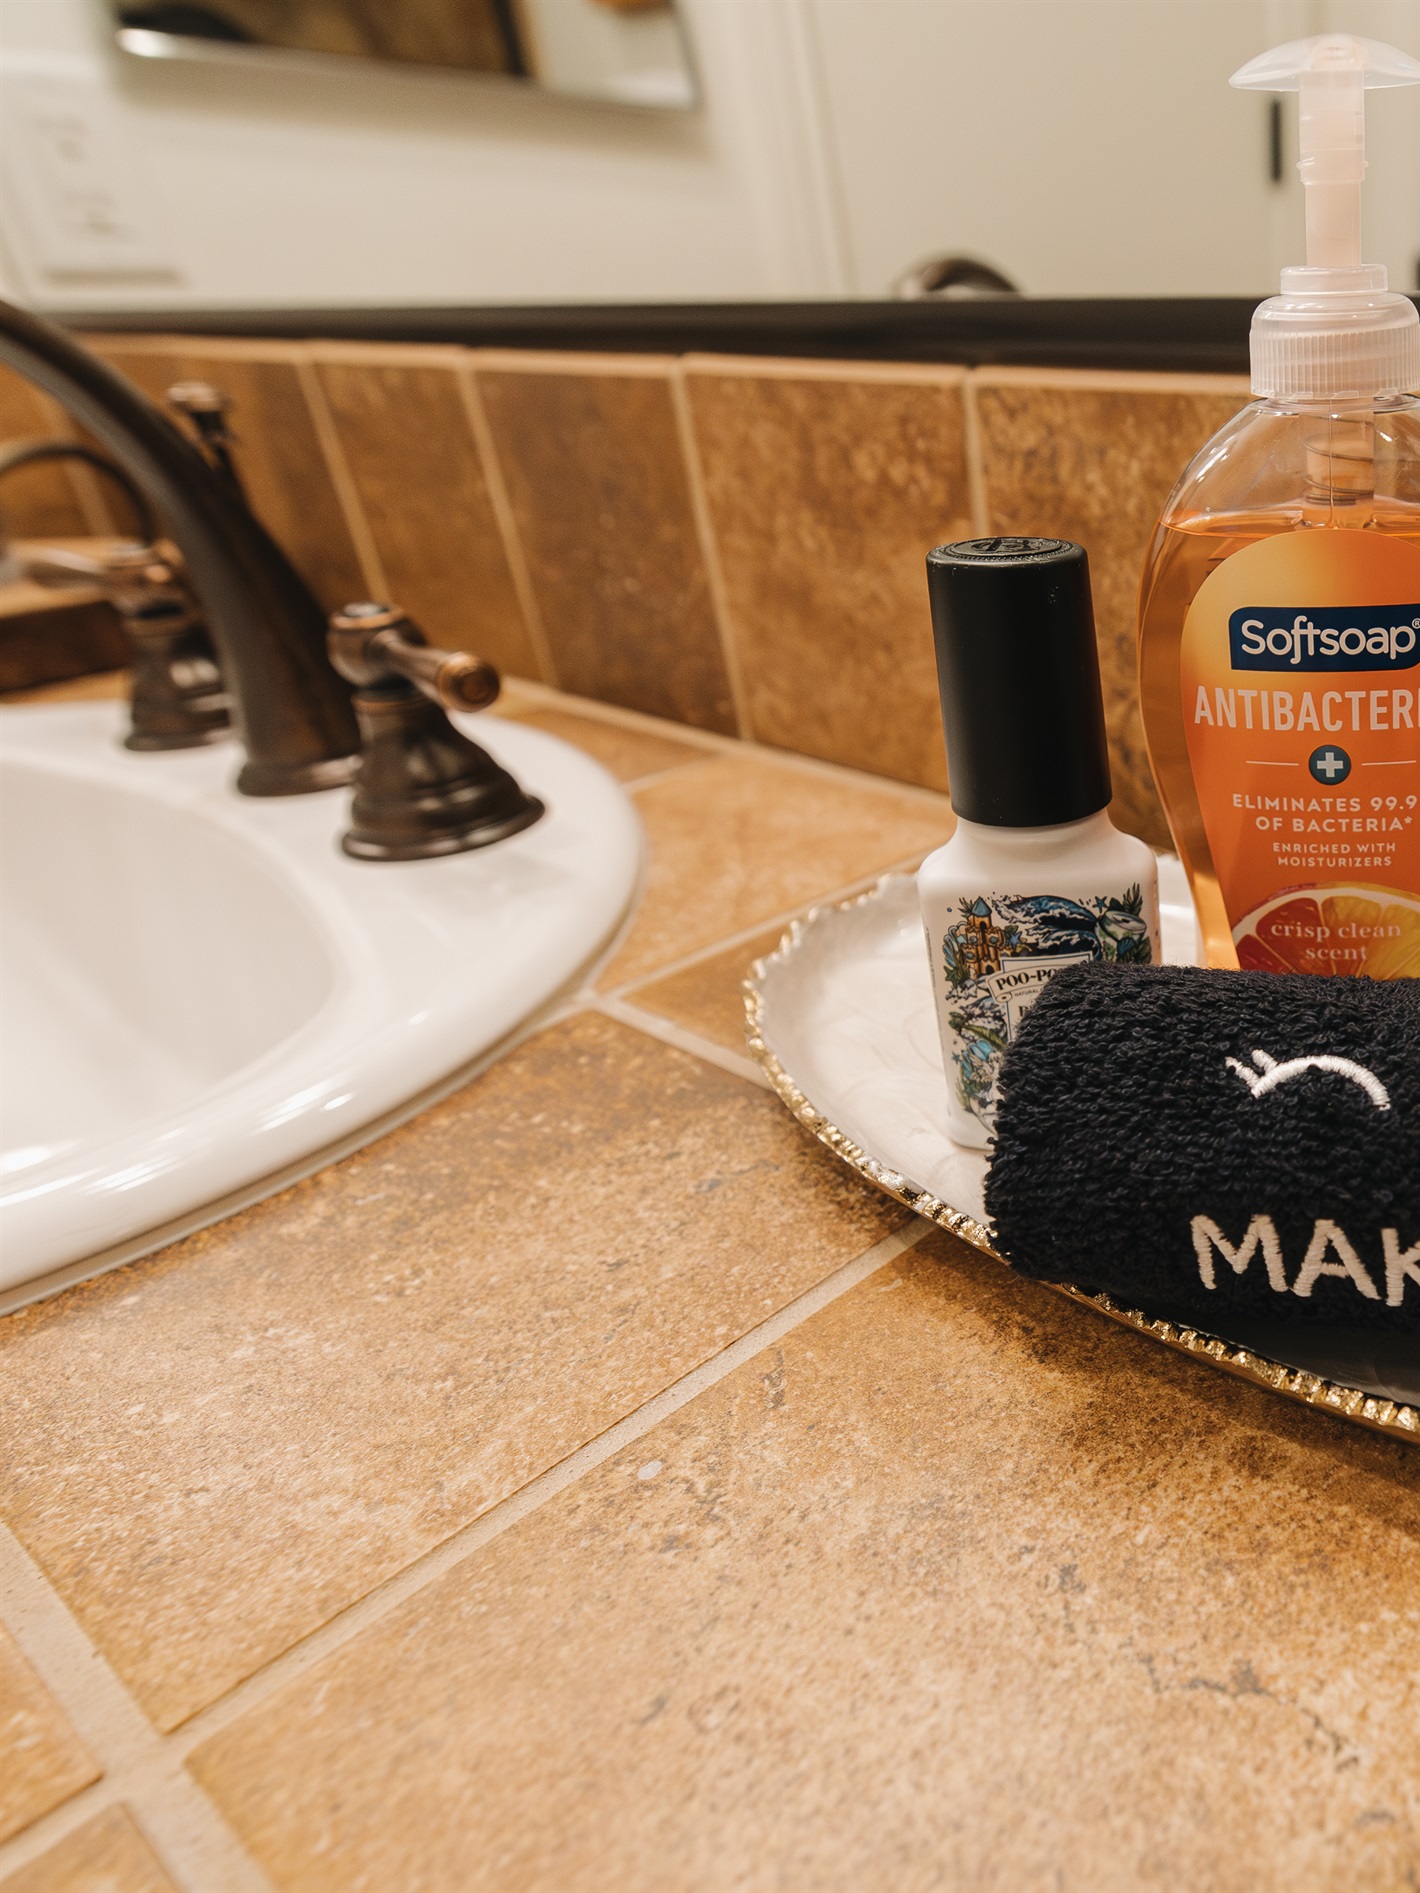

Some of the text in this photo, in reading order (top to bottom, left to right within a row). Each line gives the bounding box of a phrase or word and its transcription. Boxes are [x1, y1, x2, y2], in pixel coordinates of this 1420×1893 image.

[1233, 794, 1361, 812] ELIMINATES
[1256, 817, 1282, 831] OF
[1273, 843, 1396, 854] ENRICHED WITH
[1278, 856, 1392, 867] MOISTURIZERS
[1271, 922, 1402, 942] crisp clean
[1305, 946, 1367, 961] scent
